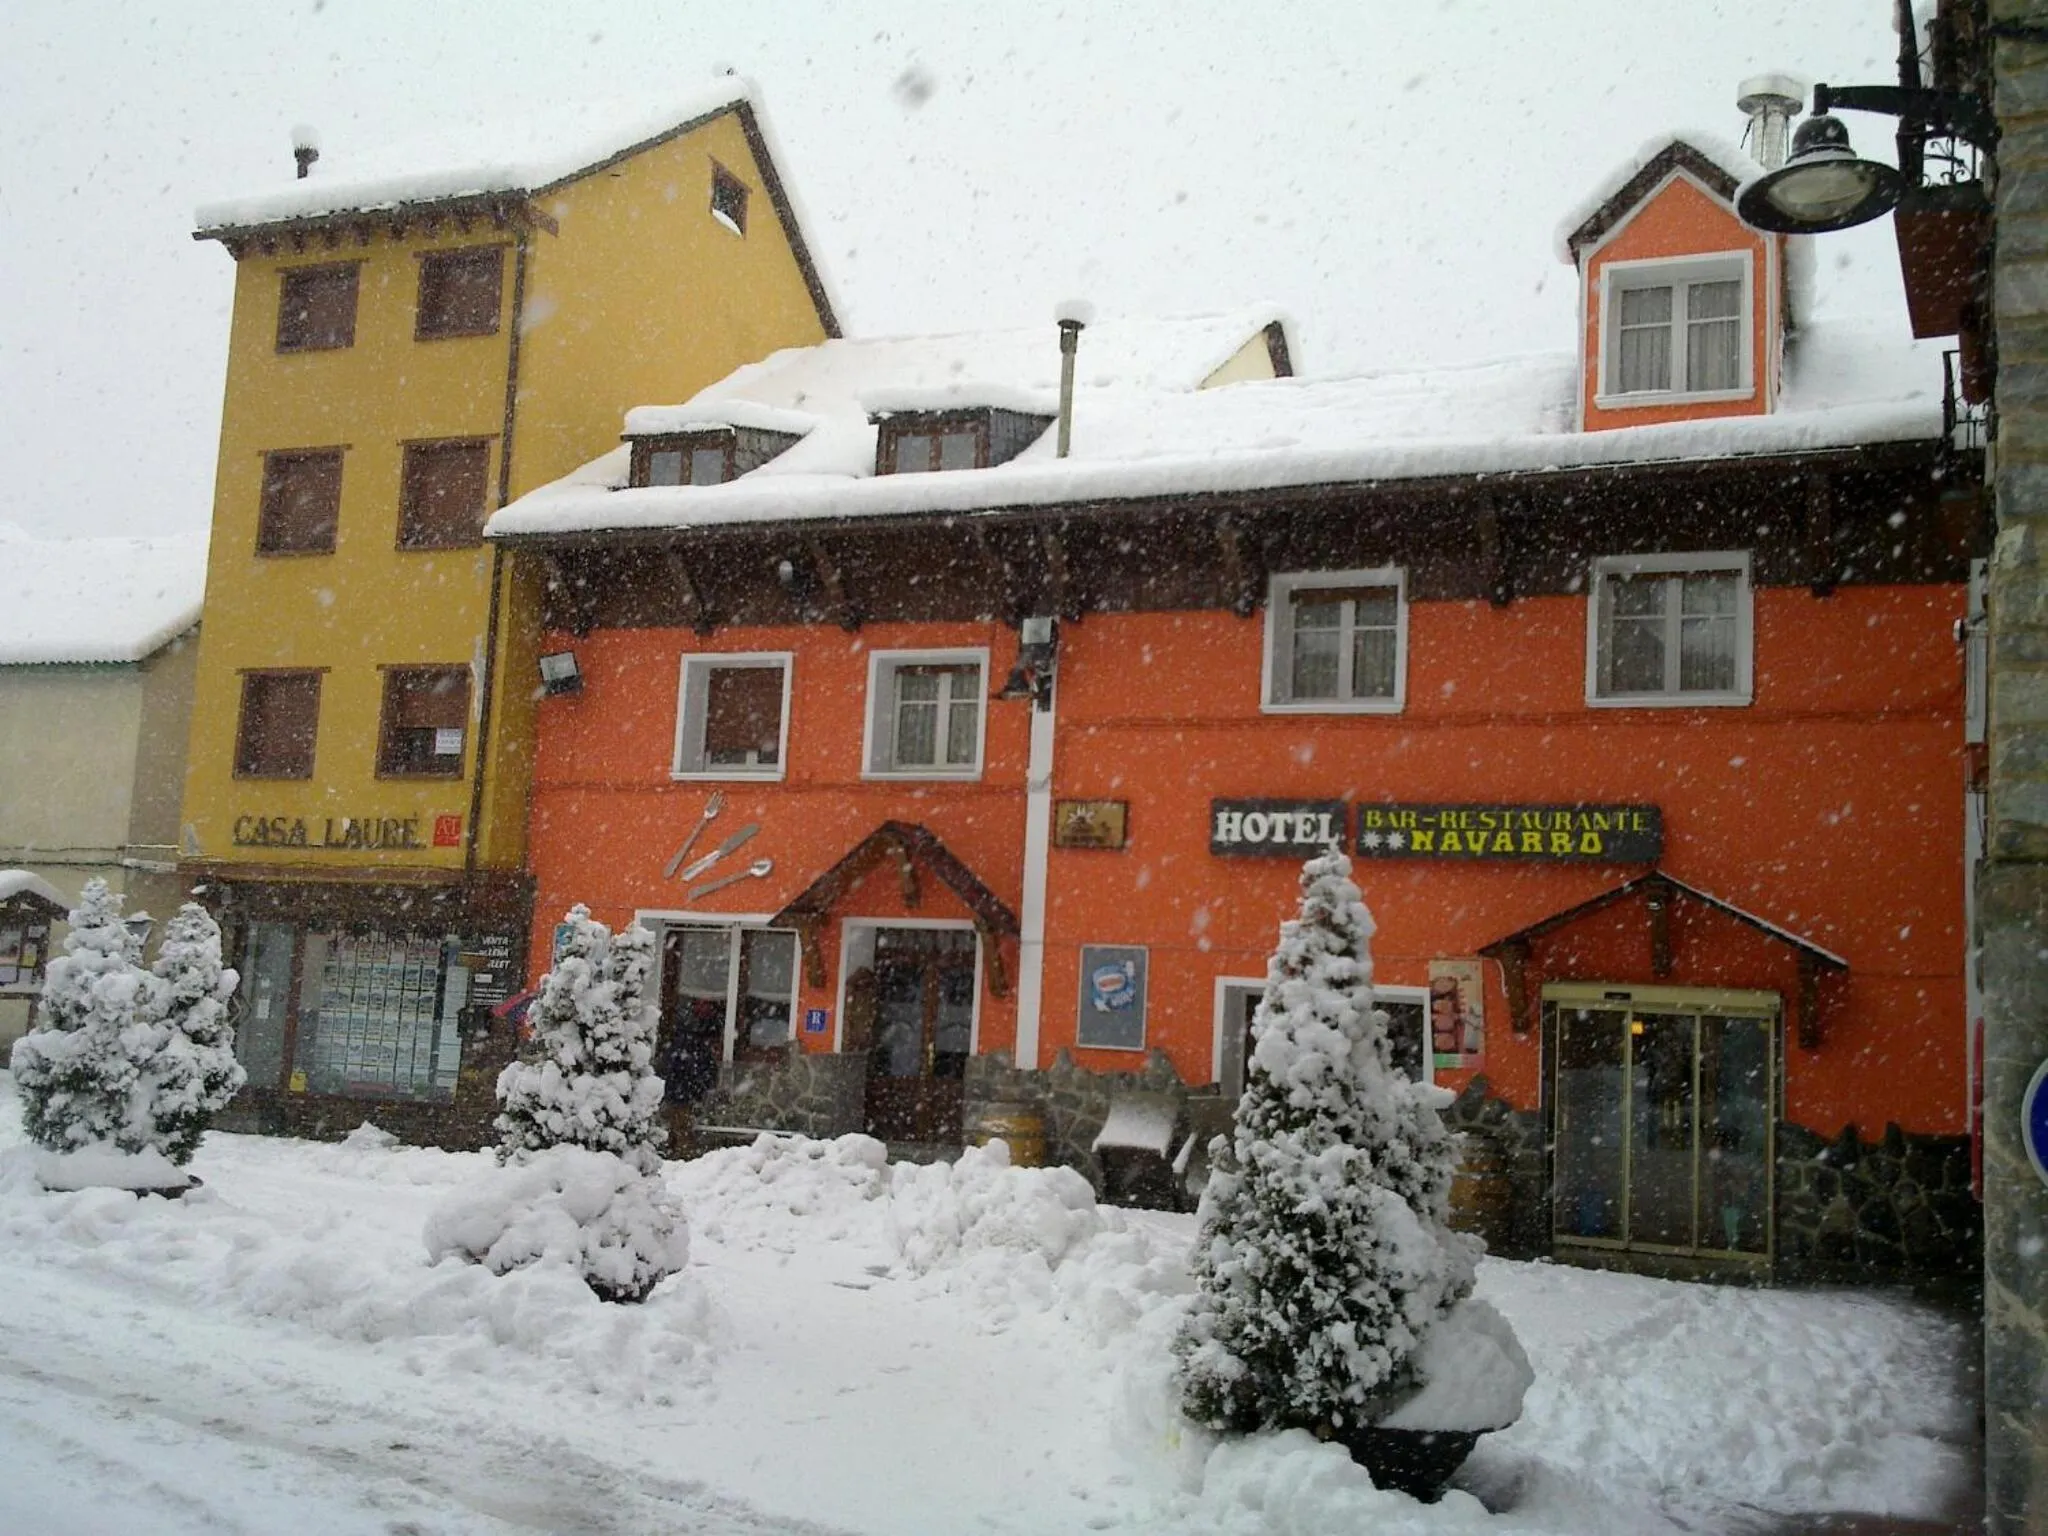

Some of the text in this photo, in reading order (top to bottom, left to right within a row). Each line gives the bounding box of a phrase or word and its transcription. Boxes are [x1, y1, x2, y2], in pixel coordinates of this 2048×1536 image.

[233, 815, 307, 847] CASA
[1214, 811, 1340, 844] HOTEL
[1366, 809, 1652, 832] BAR-RESTAURANTE
[1411, 830, 1603, 854] NAVARRO
